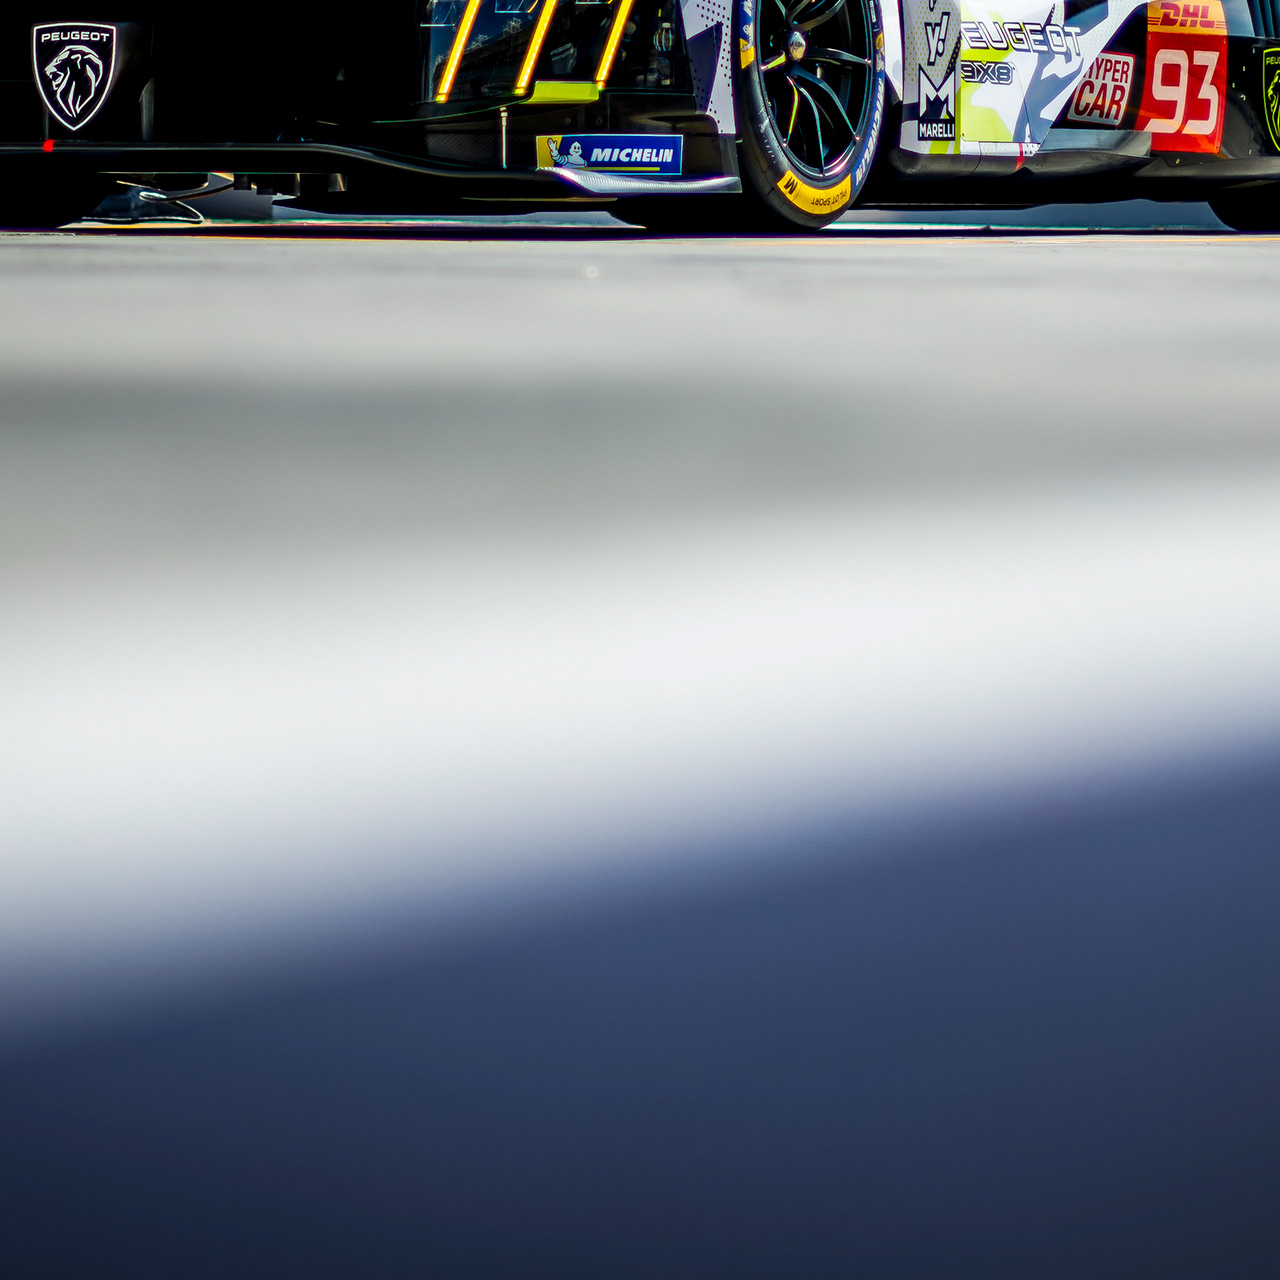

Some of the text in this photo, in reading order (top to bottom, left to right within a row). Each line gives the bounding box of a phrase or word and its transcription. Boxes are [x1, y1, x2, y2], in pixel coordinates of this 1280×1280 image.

[1160, 2, 1215, 29] DHL
[41, 31, 110, 43] PEUGEOT
[960, 21, 1081, 57] EUGEOT
[961, 60, 1013, 85] 9X8
[1073, 82, 1126, 121] CAR
[1143, 49, 1219, 135] 93
[856, 77, 884, 186] MICHELIN
[920, 122, 955, 138] MARELLI
[590, 148, 673, 162] MICHELIN
[783, 176, 798, 195] M
[811, 189, 847, 206] PILOT SPORT
